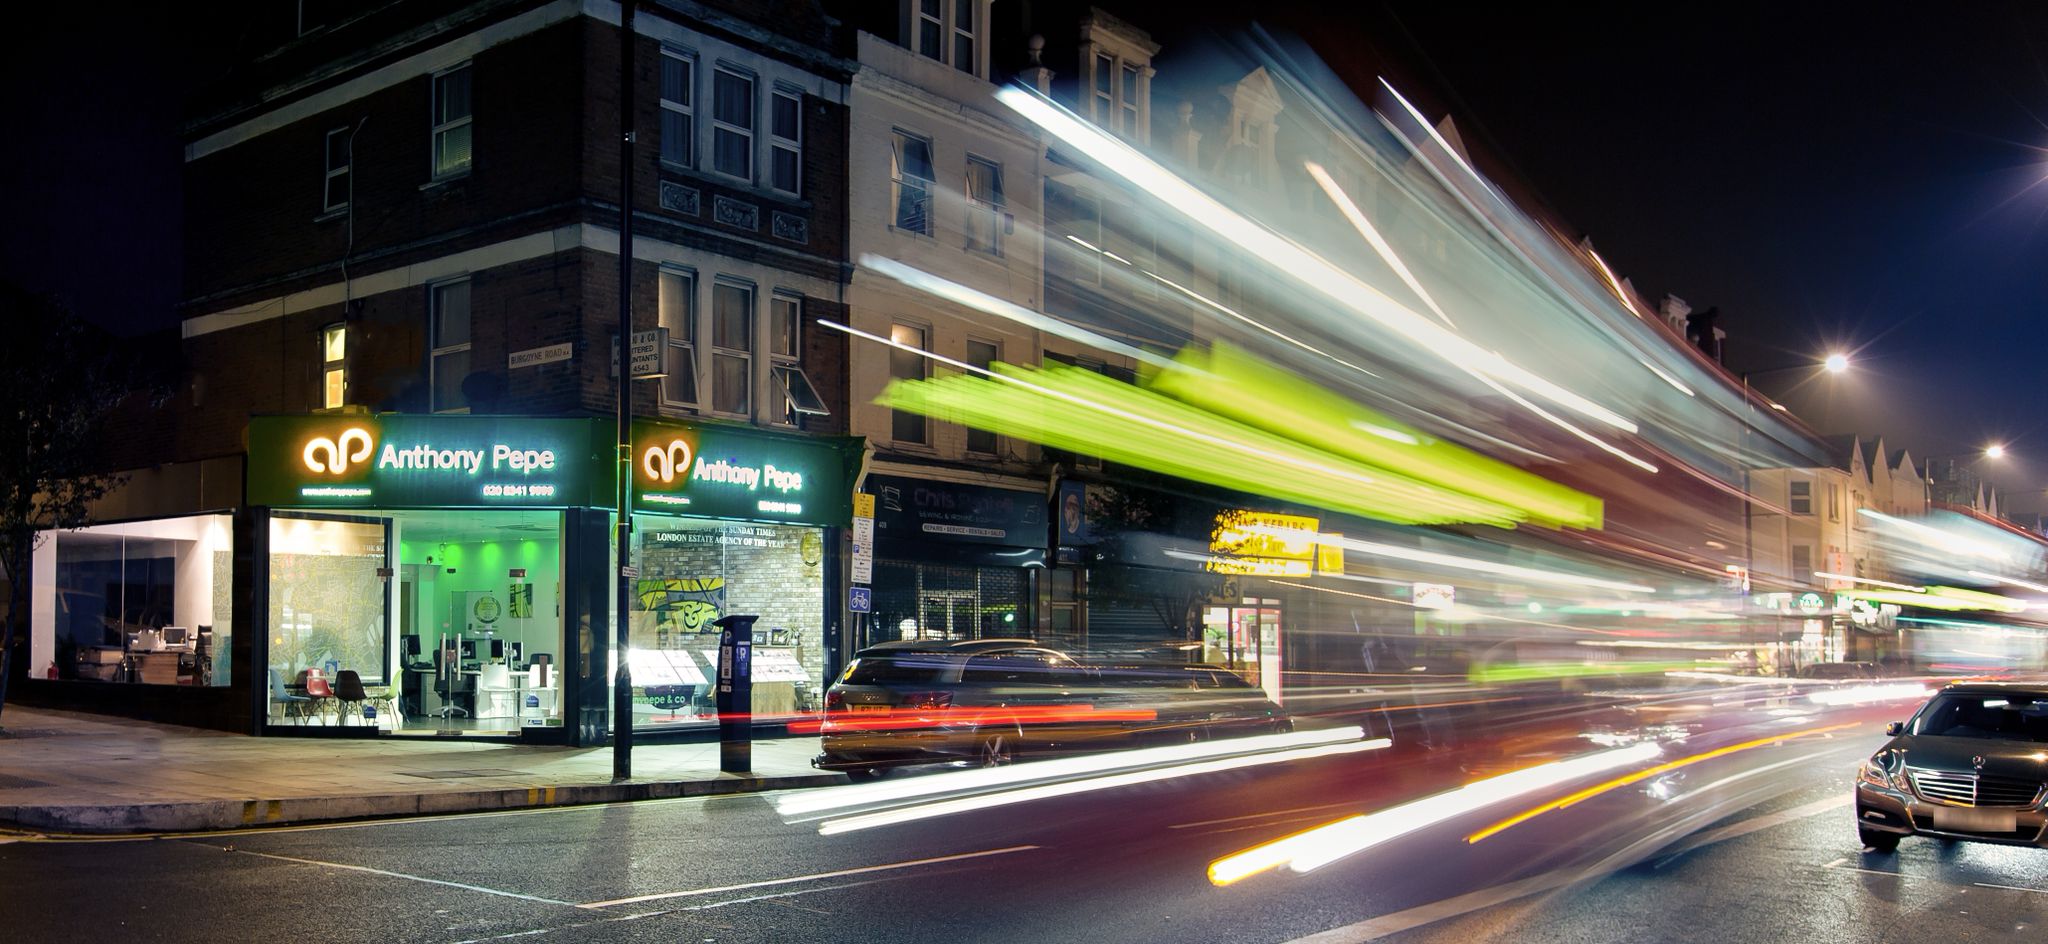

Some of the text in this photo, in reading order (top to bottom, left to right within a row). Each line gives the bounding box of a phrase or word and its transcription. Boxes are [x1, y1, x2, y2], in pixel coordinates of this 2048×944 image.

[511, 352, 543, 364] BURGOYNE
[545, 348, 562, 359] ROAD
[379, 444, 484, 474] Anthony
[493, 444, 555, 474] Pepe
[693, 457, 760, 490] Anthony
[764, 465, 802, 493] Pepe
[728, 525, 754, 535] SUNDAY
[756, 527, 776, 537] TIMES
[656, 532, 687, 542] LONDON
[688, 534, 713, 543] ESTATE
[714, 536, 744, 546] AGENCY
[743, 537, 753, 546] OF
[754, 538, 767, 547] THE
